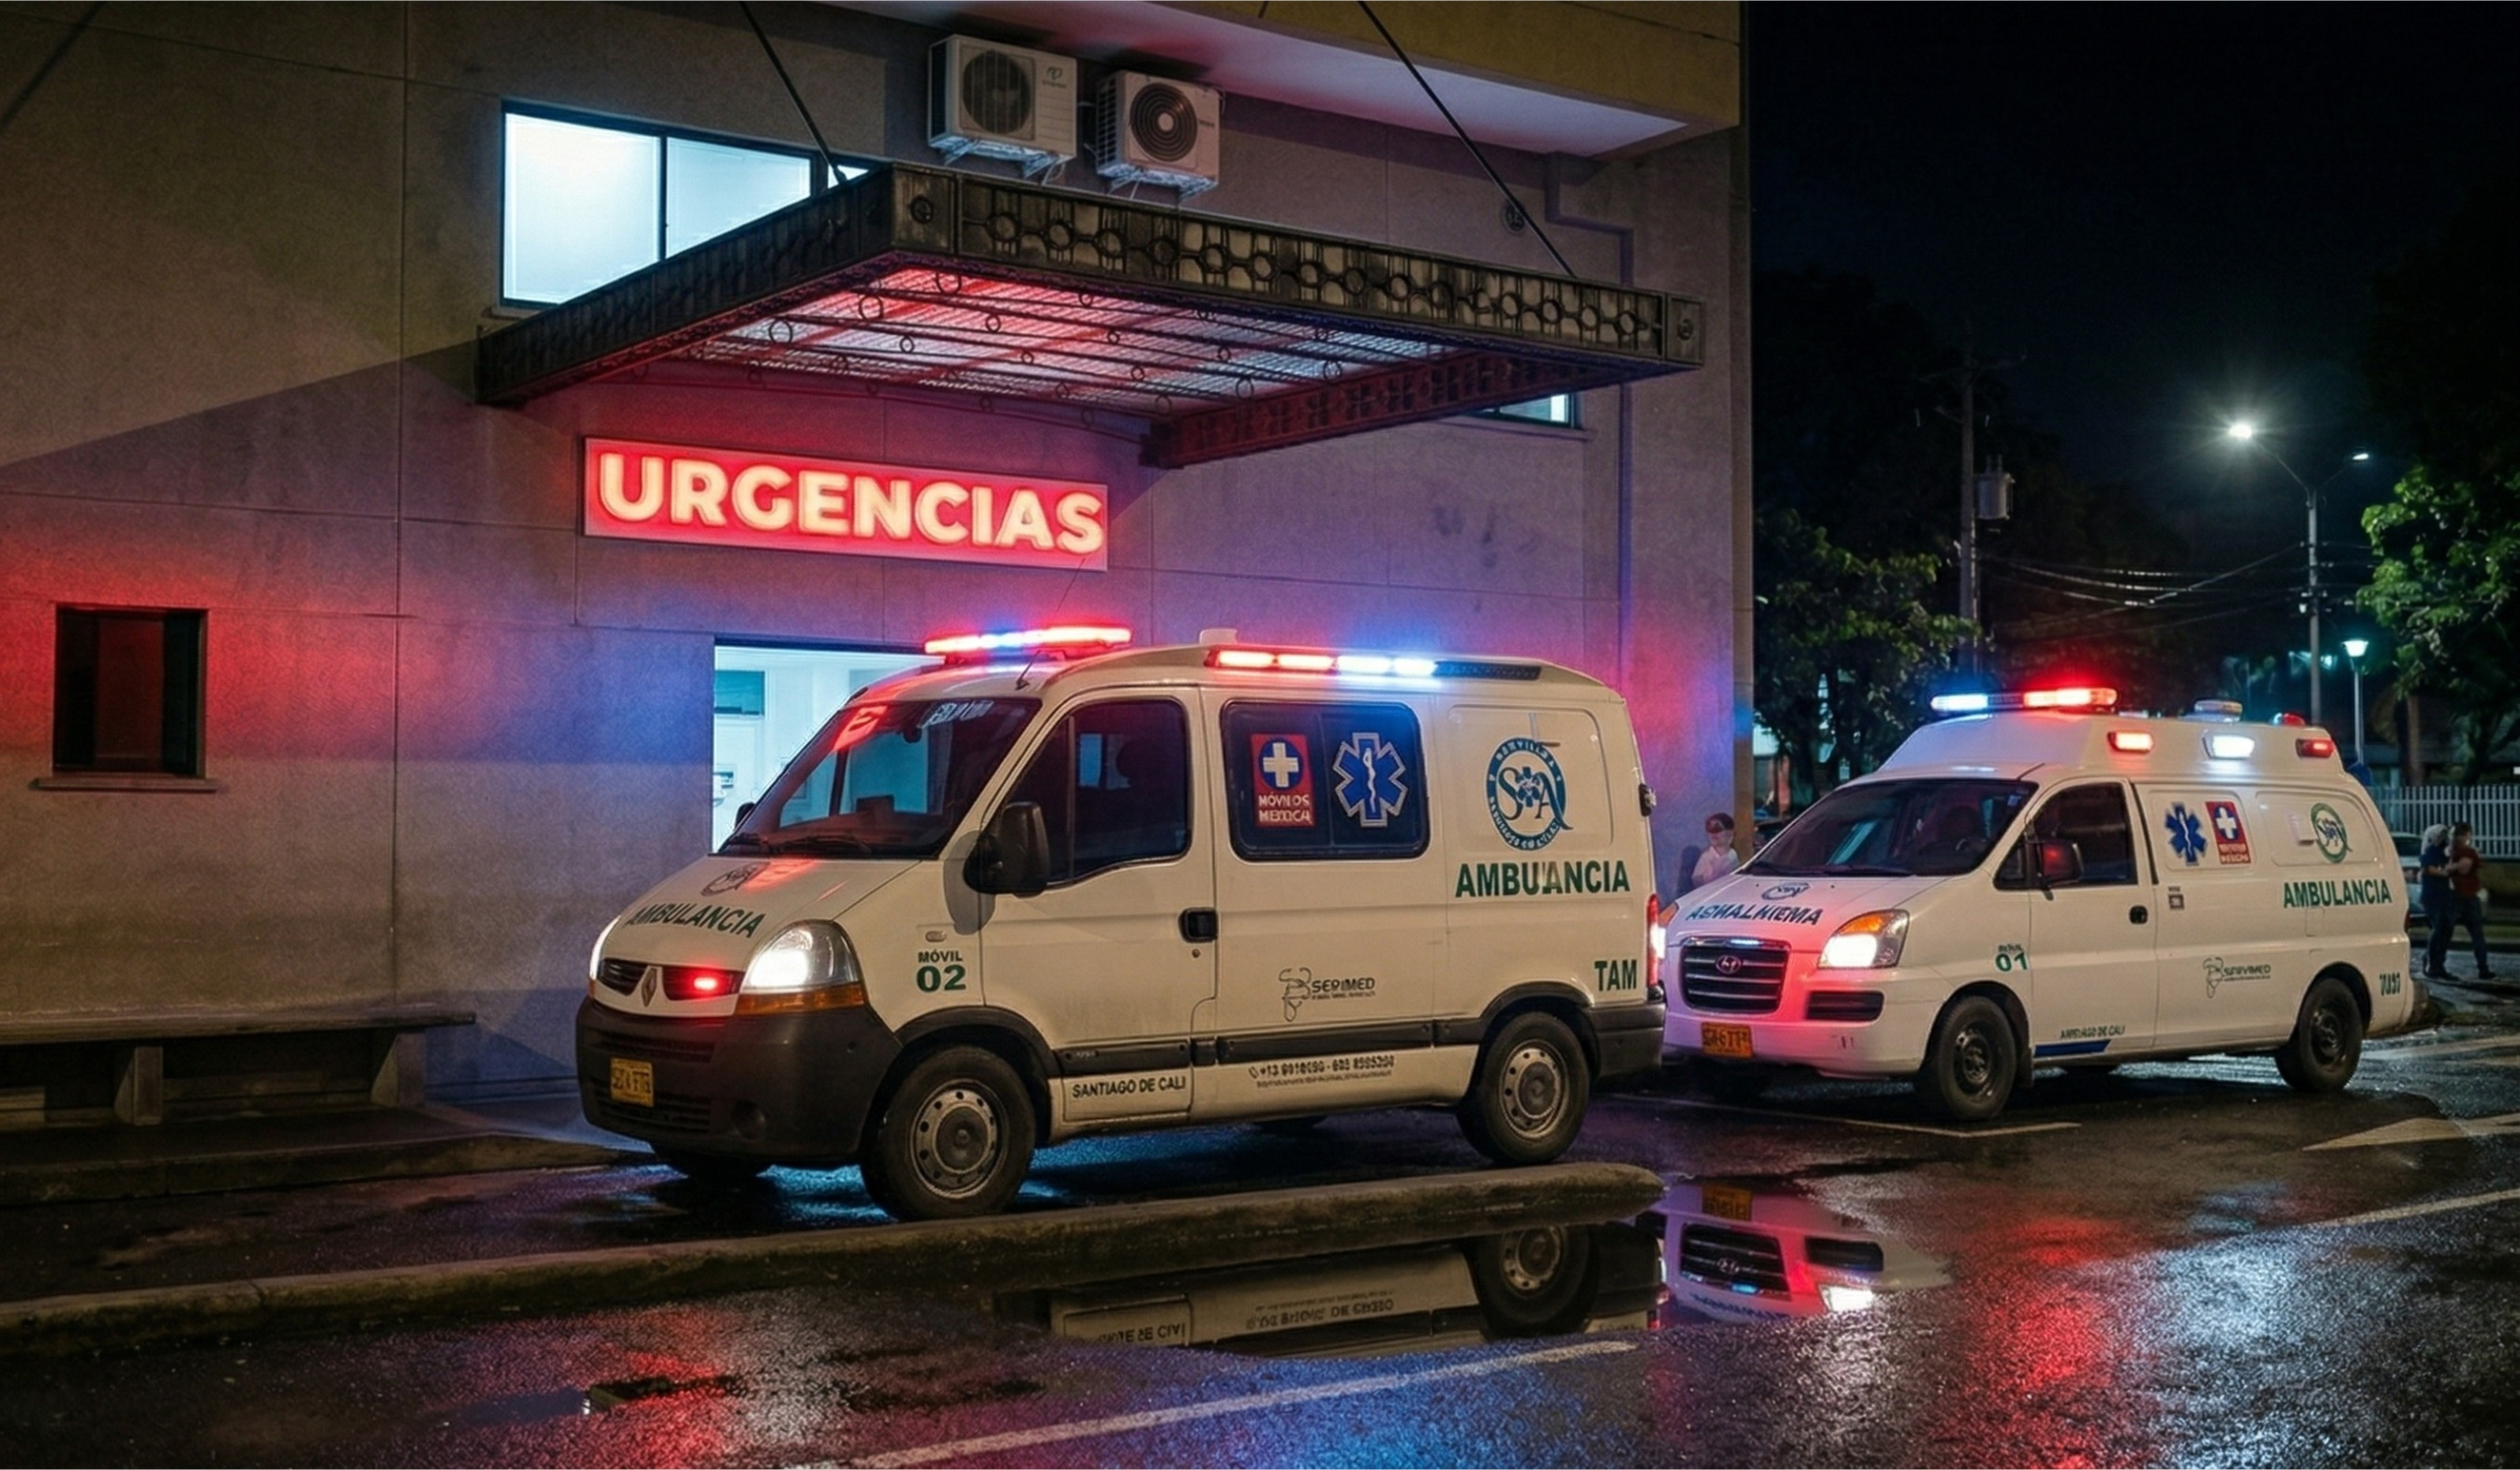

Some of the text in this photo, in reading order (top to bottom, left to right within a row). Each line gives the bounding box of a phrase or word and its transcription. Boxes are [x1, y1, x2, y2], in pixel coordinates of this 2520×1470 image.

[598, 453, 1104, 554] URGENCIAS
[2283, 879, 2393, 909] AMBULANCIA
[621, 903, 767, 939] AMBULANCIA
[917, 949, 964, 963] MÓVIL
[1995, 952, 2028, 973] 01
[916, 964, 968, 993] 02
[1594, 958, 1638, 992] TAM
[1072, 1075, 1186, 1099] SANTIAGO DE CALI
